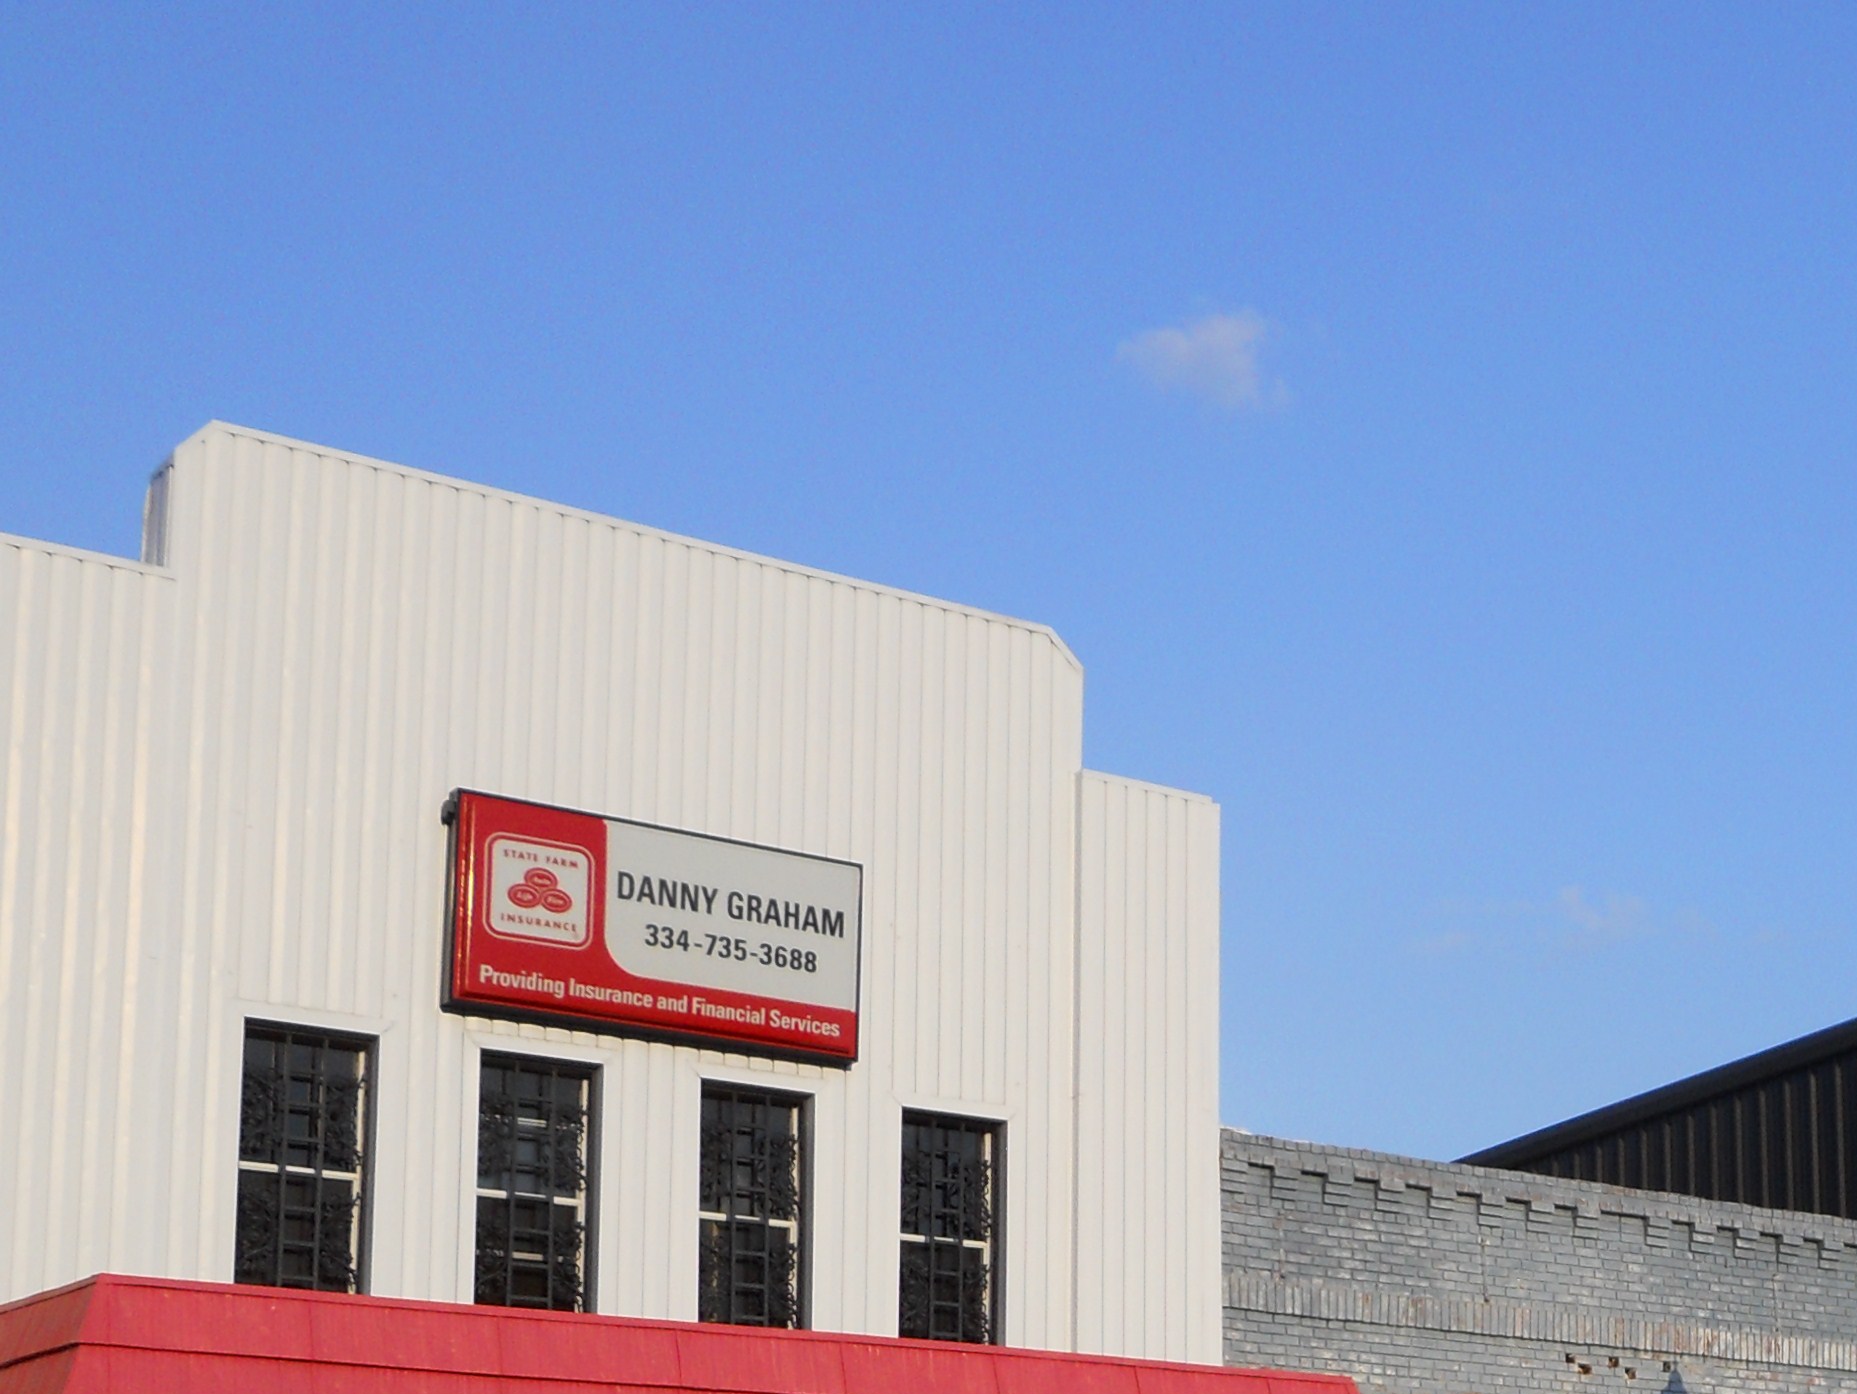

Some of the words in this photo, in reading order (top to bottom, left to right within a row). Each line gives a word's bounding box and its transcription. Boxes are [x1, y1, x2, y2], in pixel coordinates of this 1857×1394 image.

[503, 849, 538, 862] STATE
[545, 856, 579, 869] FARM
[500, 913, 577, 932] INSURANCE
[617, 870, 719, 915] DANNY
[728, 891, 845, 938] GRAHAM
[644, 924, 818, 973] 334-735-3688
[479, 964, 564, 998] Providing
[569, 977, 654, 1009] Insurance
[657, 994, 688, 1015] and
[692, 998, 766, 1026] Financial
[770, 1010, 841, 1037] Services
